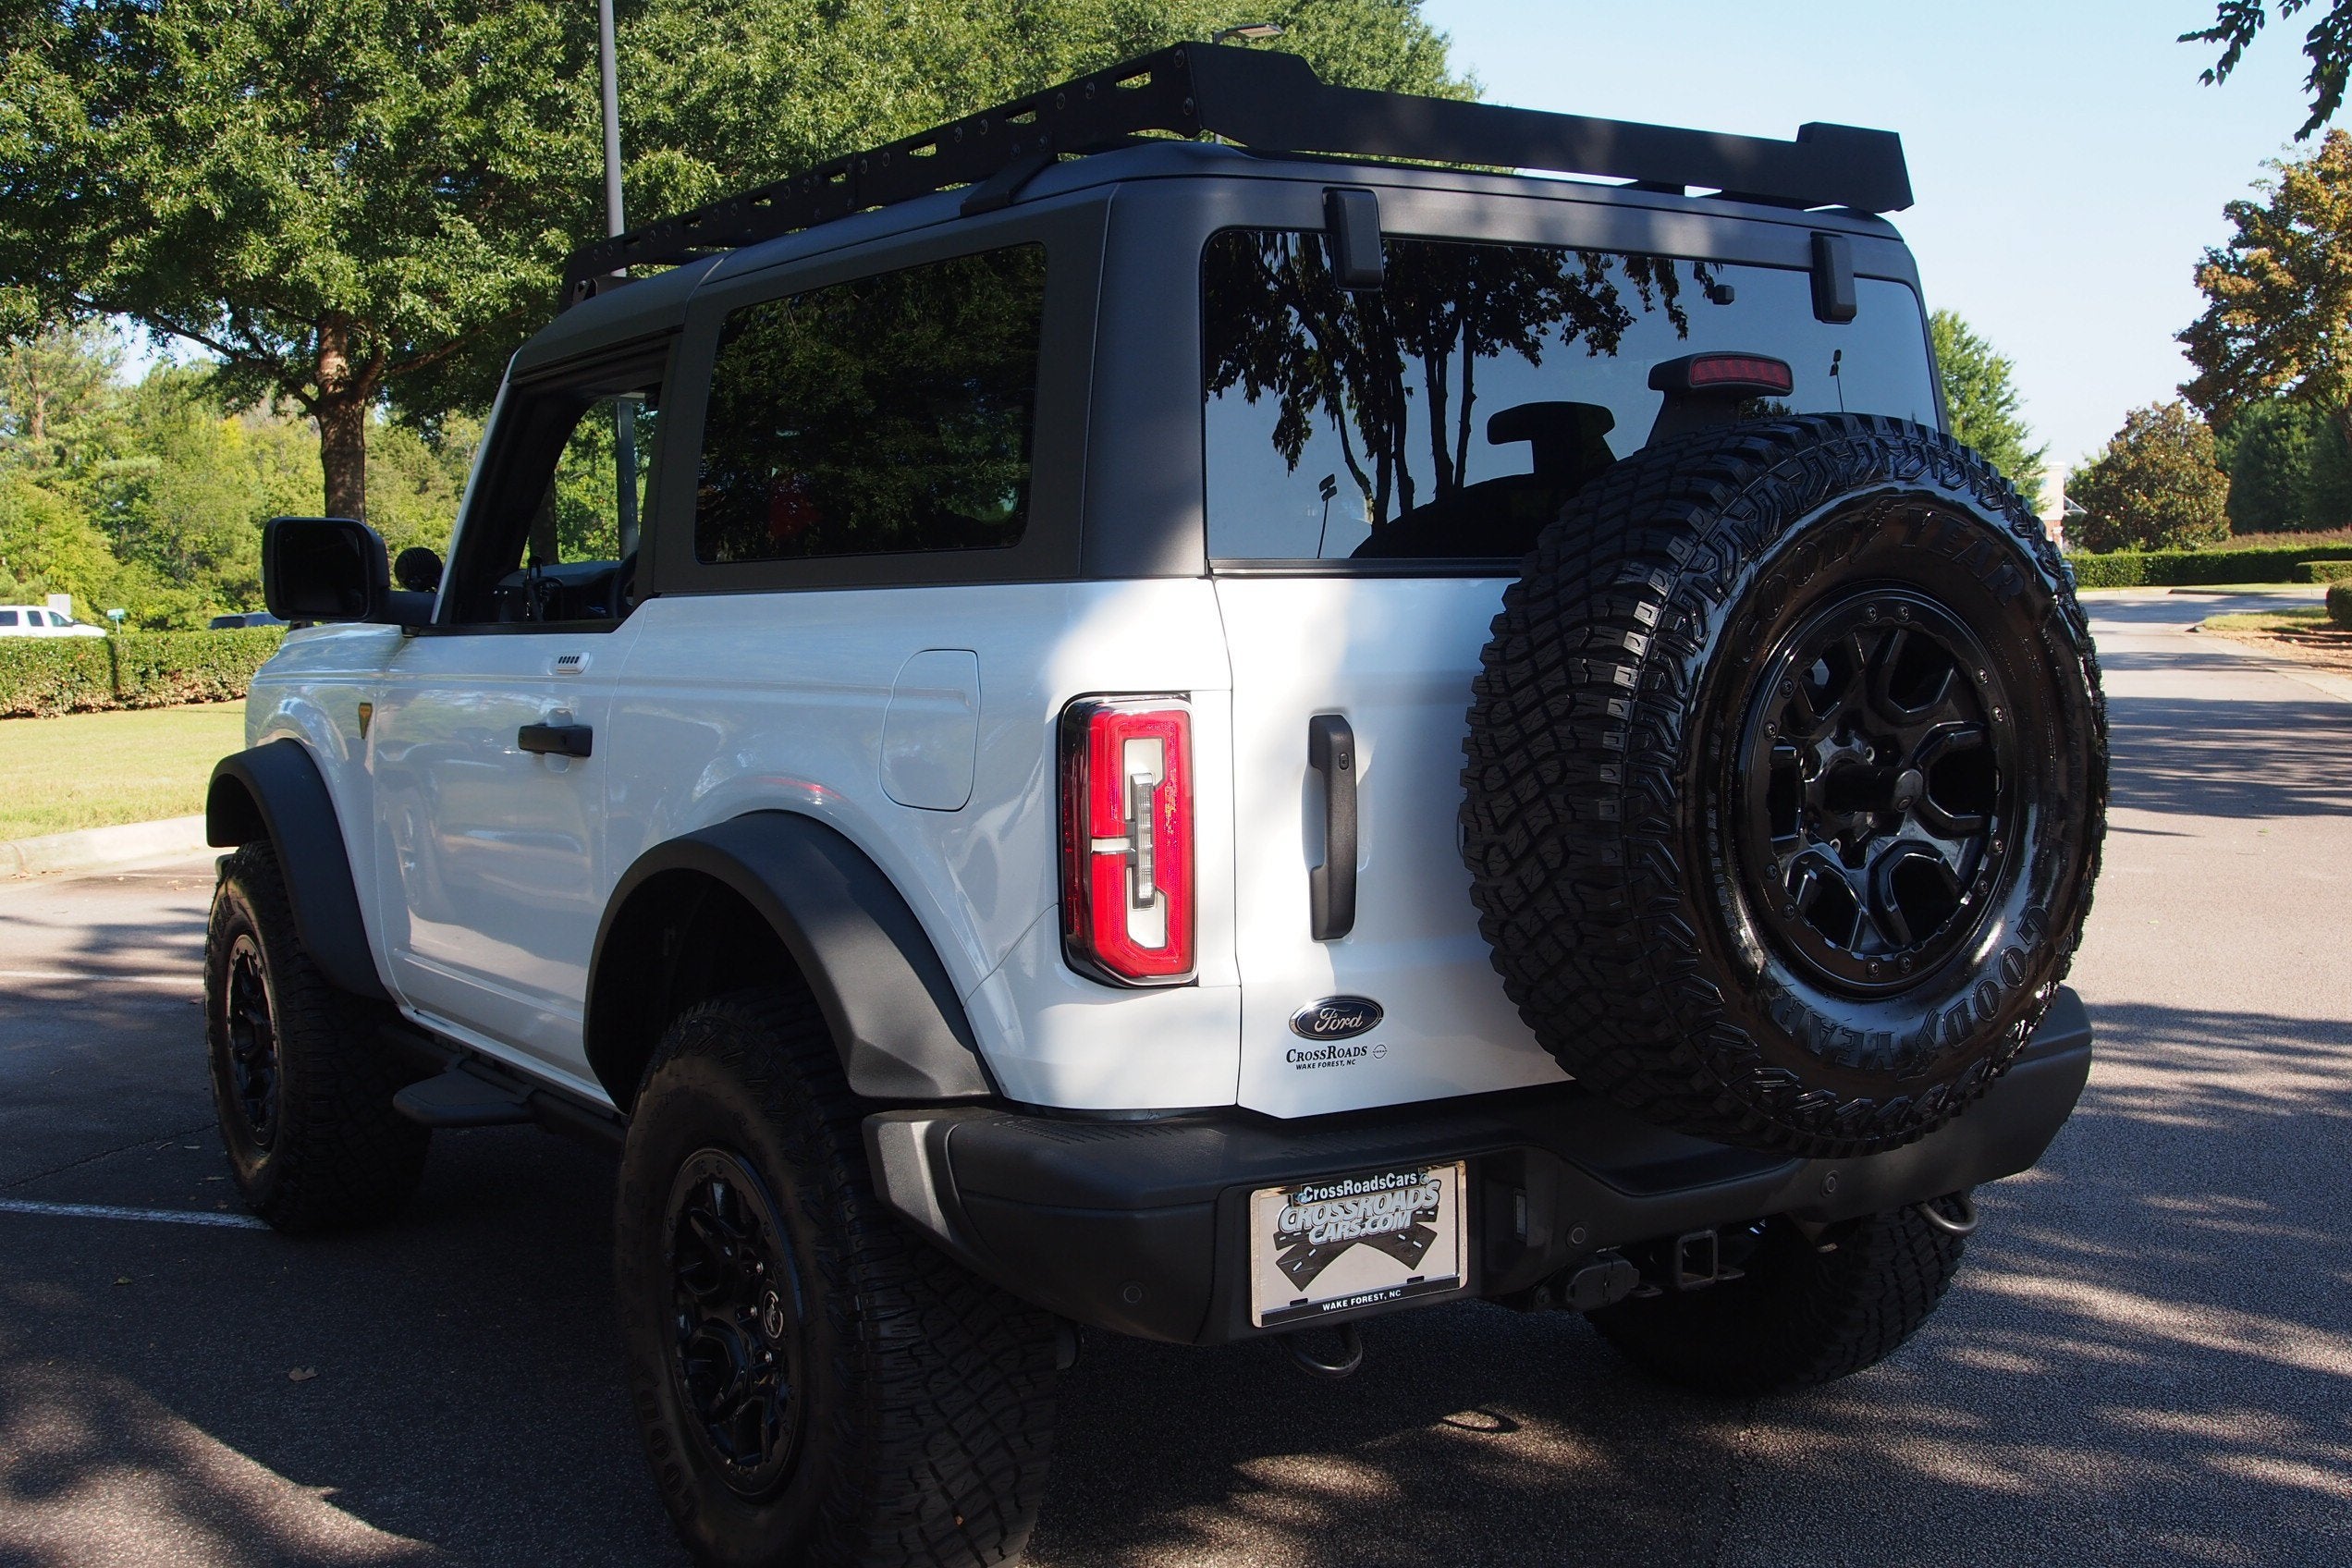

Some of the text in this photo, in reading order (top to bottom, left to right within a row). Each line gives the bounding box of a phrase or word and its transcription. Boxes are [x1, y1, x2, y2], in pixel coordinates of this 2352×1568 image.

[1314, 1008, 1363, 1032] Ford
[1317, 1060, 1345, 1069] FOREST,
[1302, 1172, 1417, 1204] CrossRoadsCars
[1278, 1178, 1442, 1233] CROSSROADS
[1308, 1210, 1413, 1244] CARS.COM
[1322, 1289, 1402, 1311] WAKE FOREST, NC
